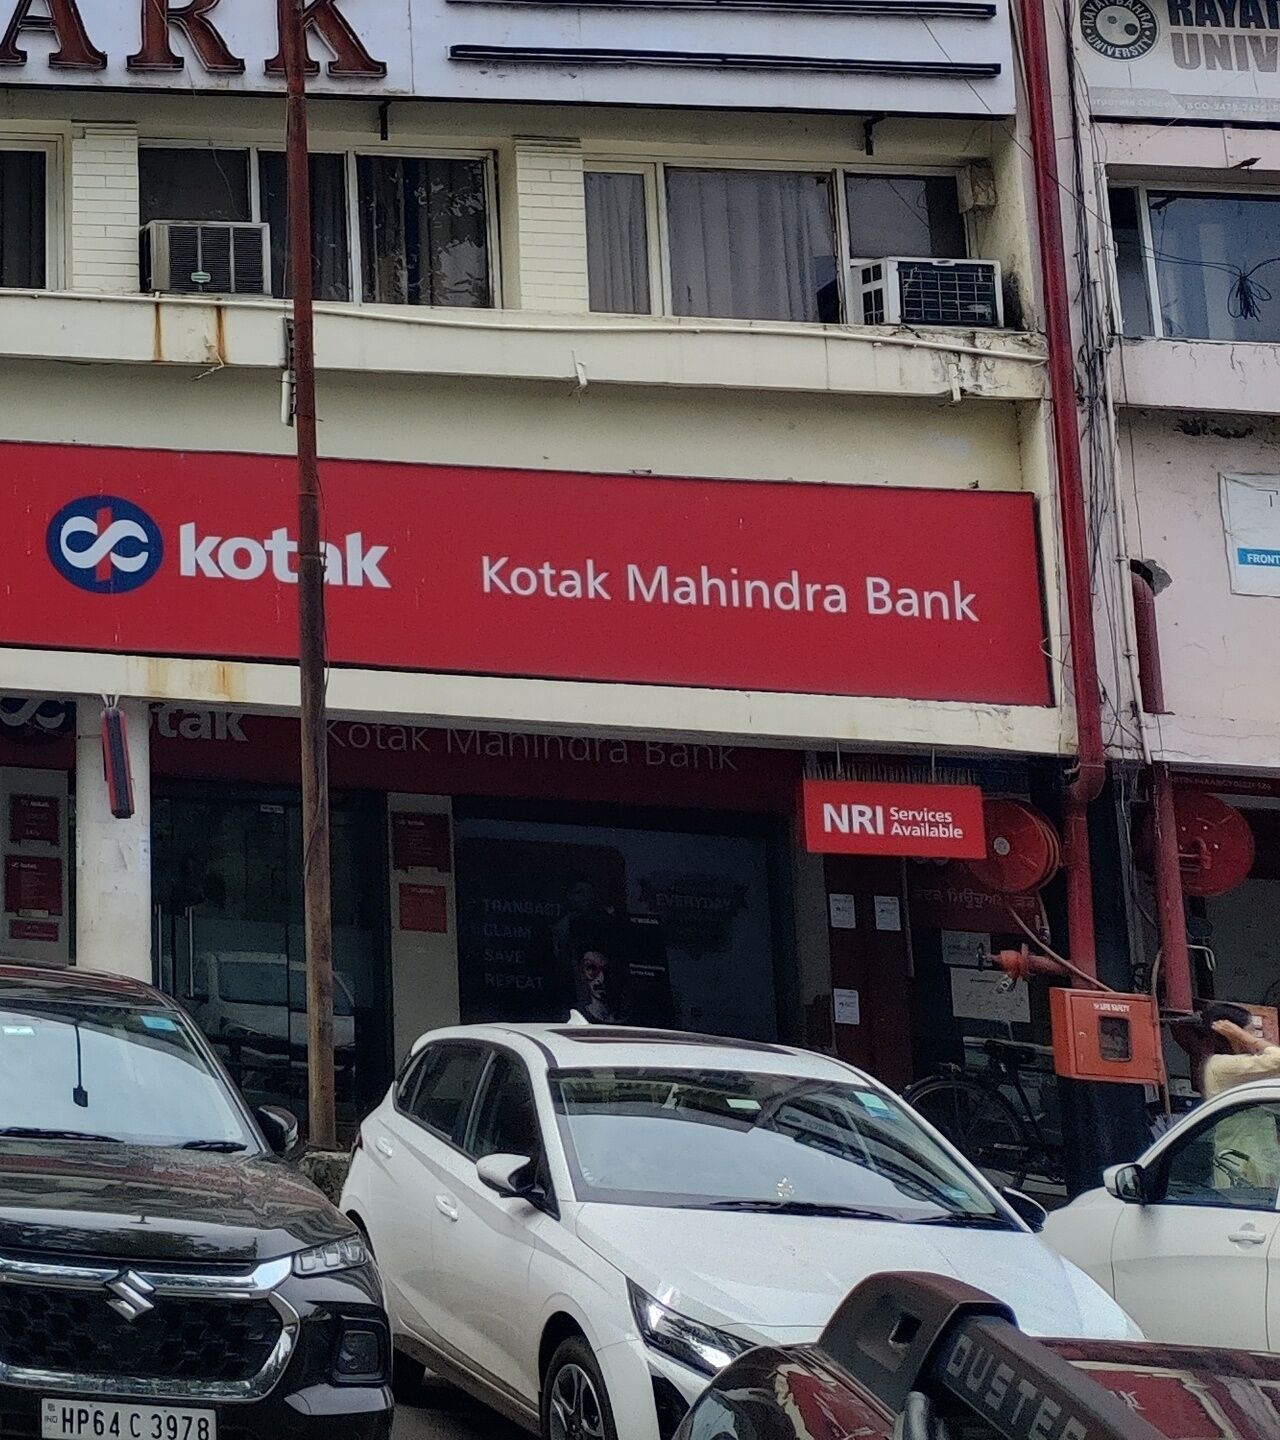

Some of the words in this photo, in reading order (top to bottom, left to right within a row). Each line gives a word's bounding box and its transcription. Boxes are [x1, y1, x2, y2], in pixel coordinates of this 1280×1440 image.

[1086, 34, 1153, 58] UNIVERSITY
[1171, 32, 1278, 73] UNIV
[179, 522, 392, 588] kotak
[1248, 553, 1280, 566] FRONT
[481, 553, 613, 601] Kotak
[627, 563, 849, 614] Mahindra
[867, 576, 980, 622] Bank
[322, 721, 430, 754] Kotak
[444, 725, 631, 766] Mahindra
[645, 741, 739, 773] Bank
[823, 802, 885, 835] NRI
[890, 807, 953, 823] Services
[891, 822, 964, 839] Available
[656, 892, 735, 911] EVERYDAY
[483, 922, 532, 940] CLAIM
[484, 948, 525, 965] SAVE
[484, 972, 546, 990] REPEAT
[62, 1407, 120, 1438] HP64
[130, 1413, 141, 1438] C
[151, 1414, 210, 1440] 3978
